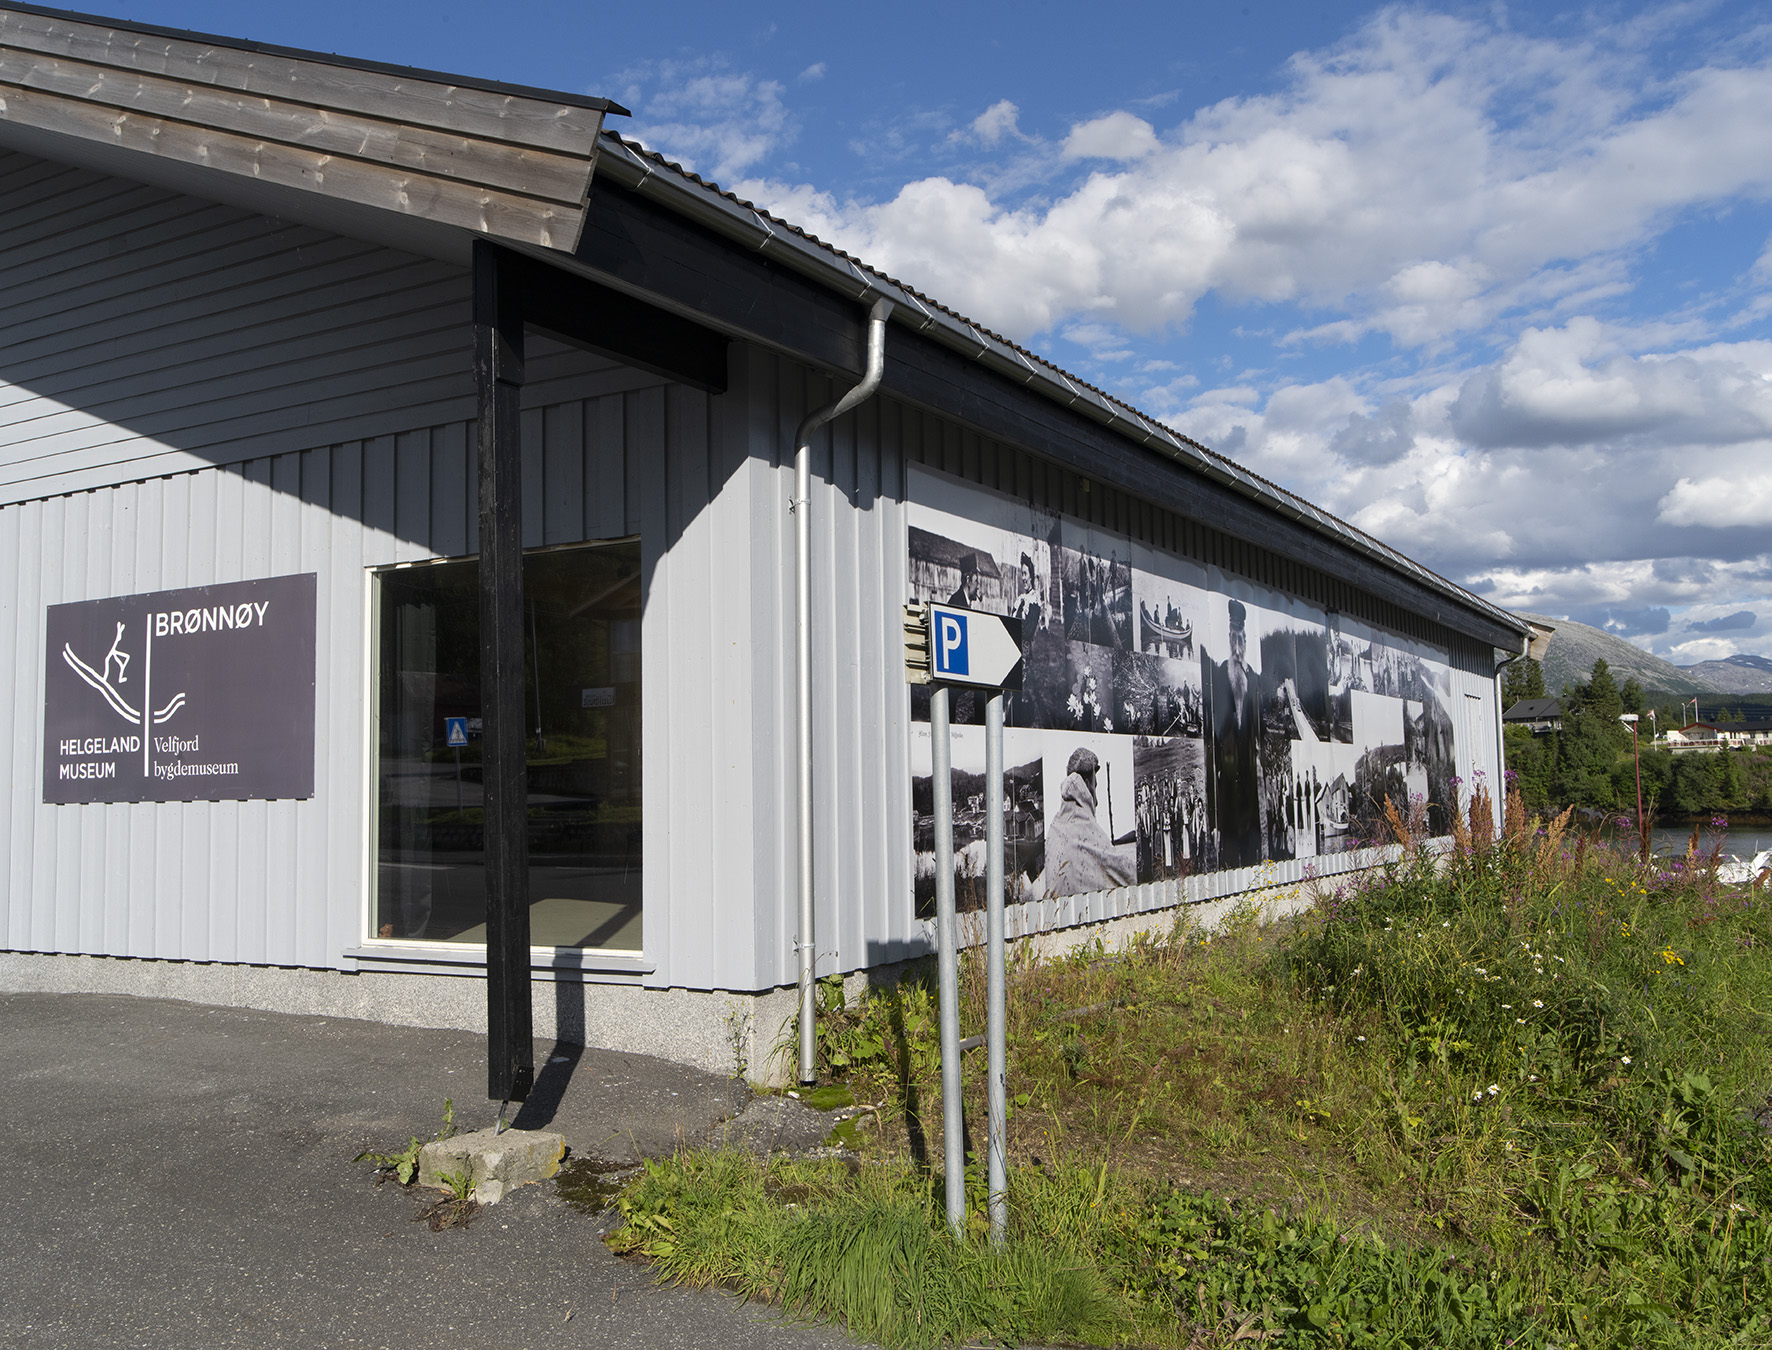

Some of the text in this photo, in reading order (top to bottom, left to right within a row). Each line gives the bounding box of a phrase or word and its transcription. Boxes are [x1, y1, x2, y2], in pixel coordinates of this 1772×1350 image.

[155, 601, 270, 637] BRØNNØY
[942, 616, 962, 670] P
[60, 736, 141, 755] HELGELAND
[154, 734, 199, 756] Velfjord
[59, 762, 115, 780] MUSEUM
[154, 760, 239, 780] bygdemuseum
